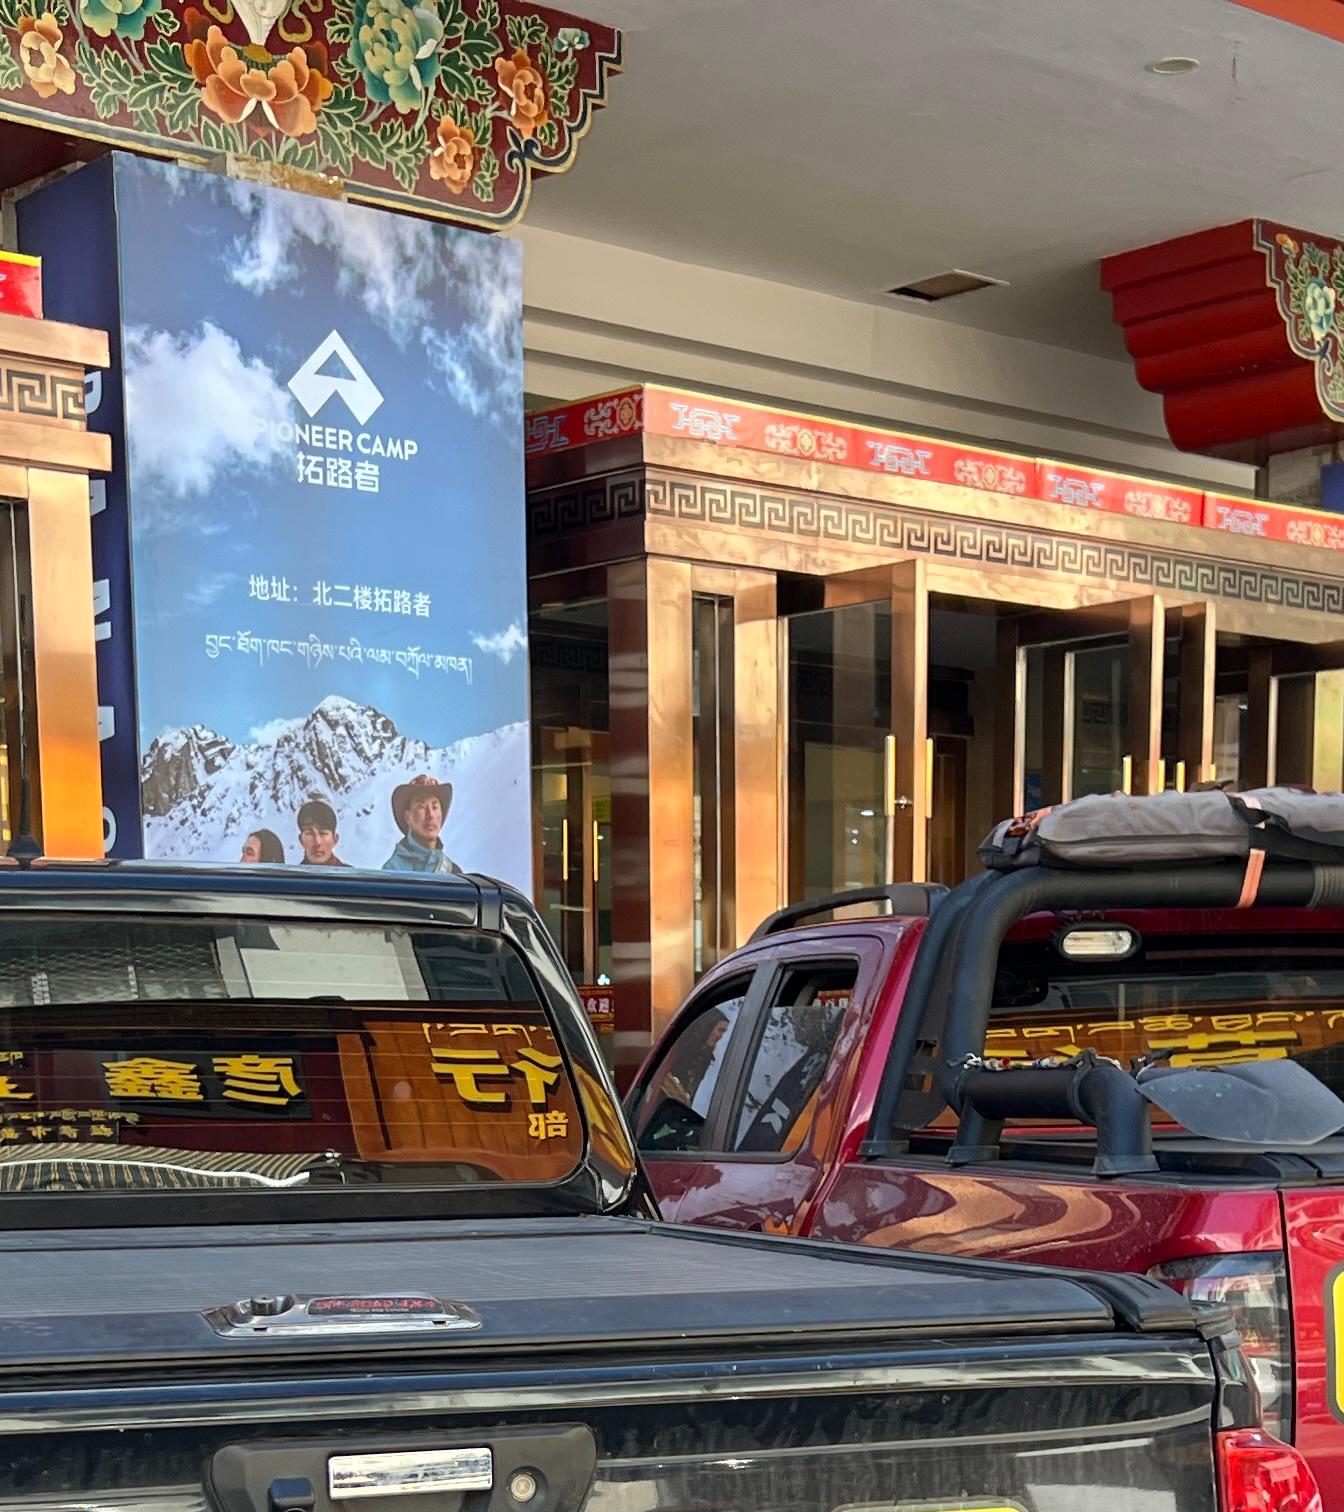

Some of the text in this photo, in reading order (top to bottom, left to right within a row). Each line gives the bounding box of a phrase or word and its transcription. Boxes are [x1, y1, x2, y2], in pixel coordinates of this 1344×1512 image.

[356, 433, 419, 461] CAMP
[296, 451, 380, 493] 拓路者
